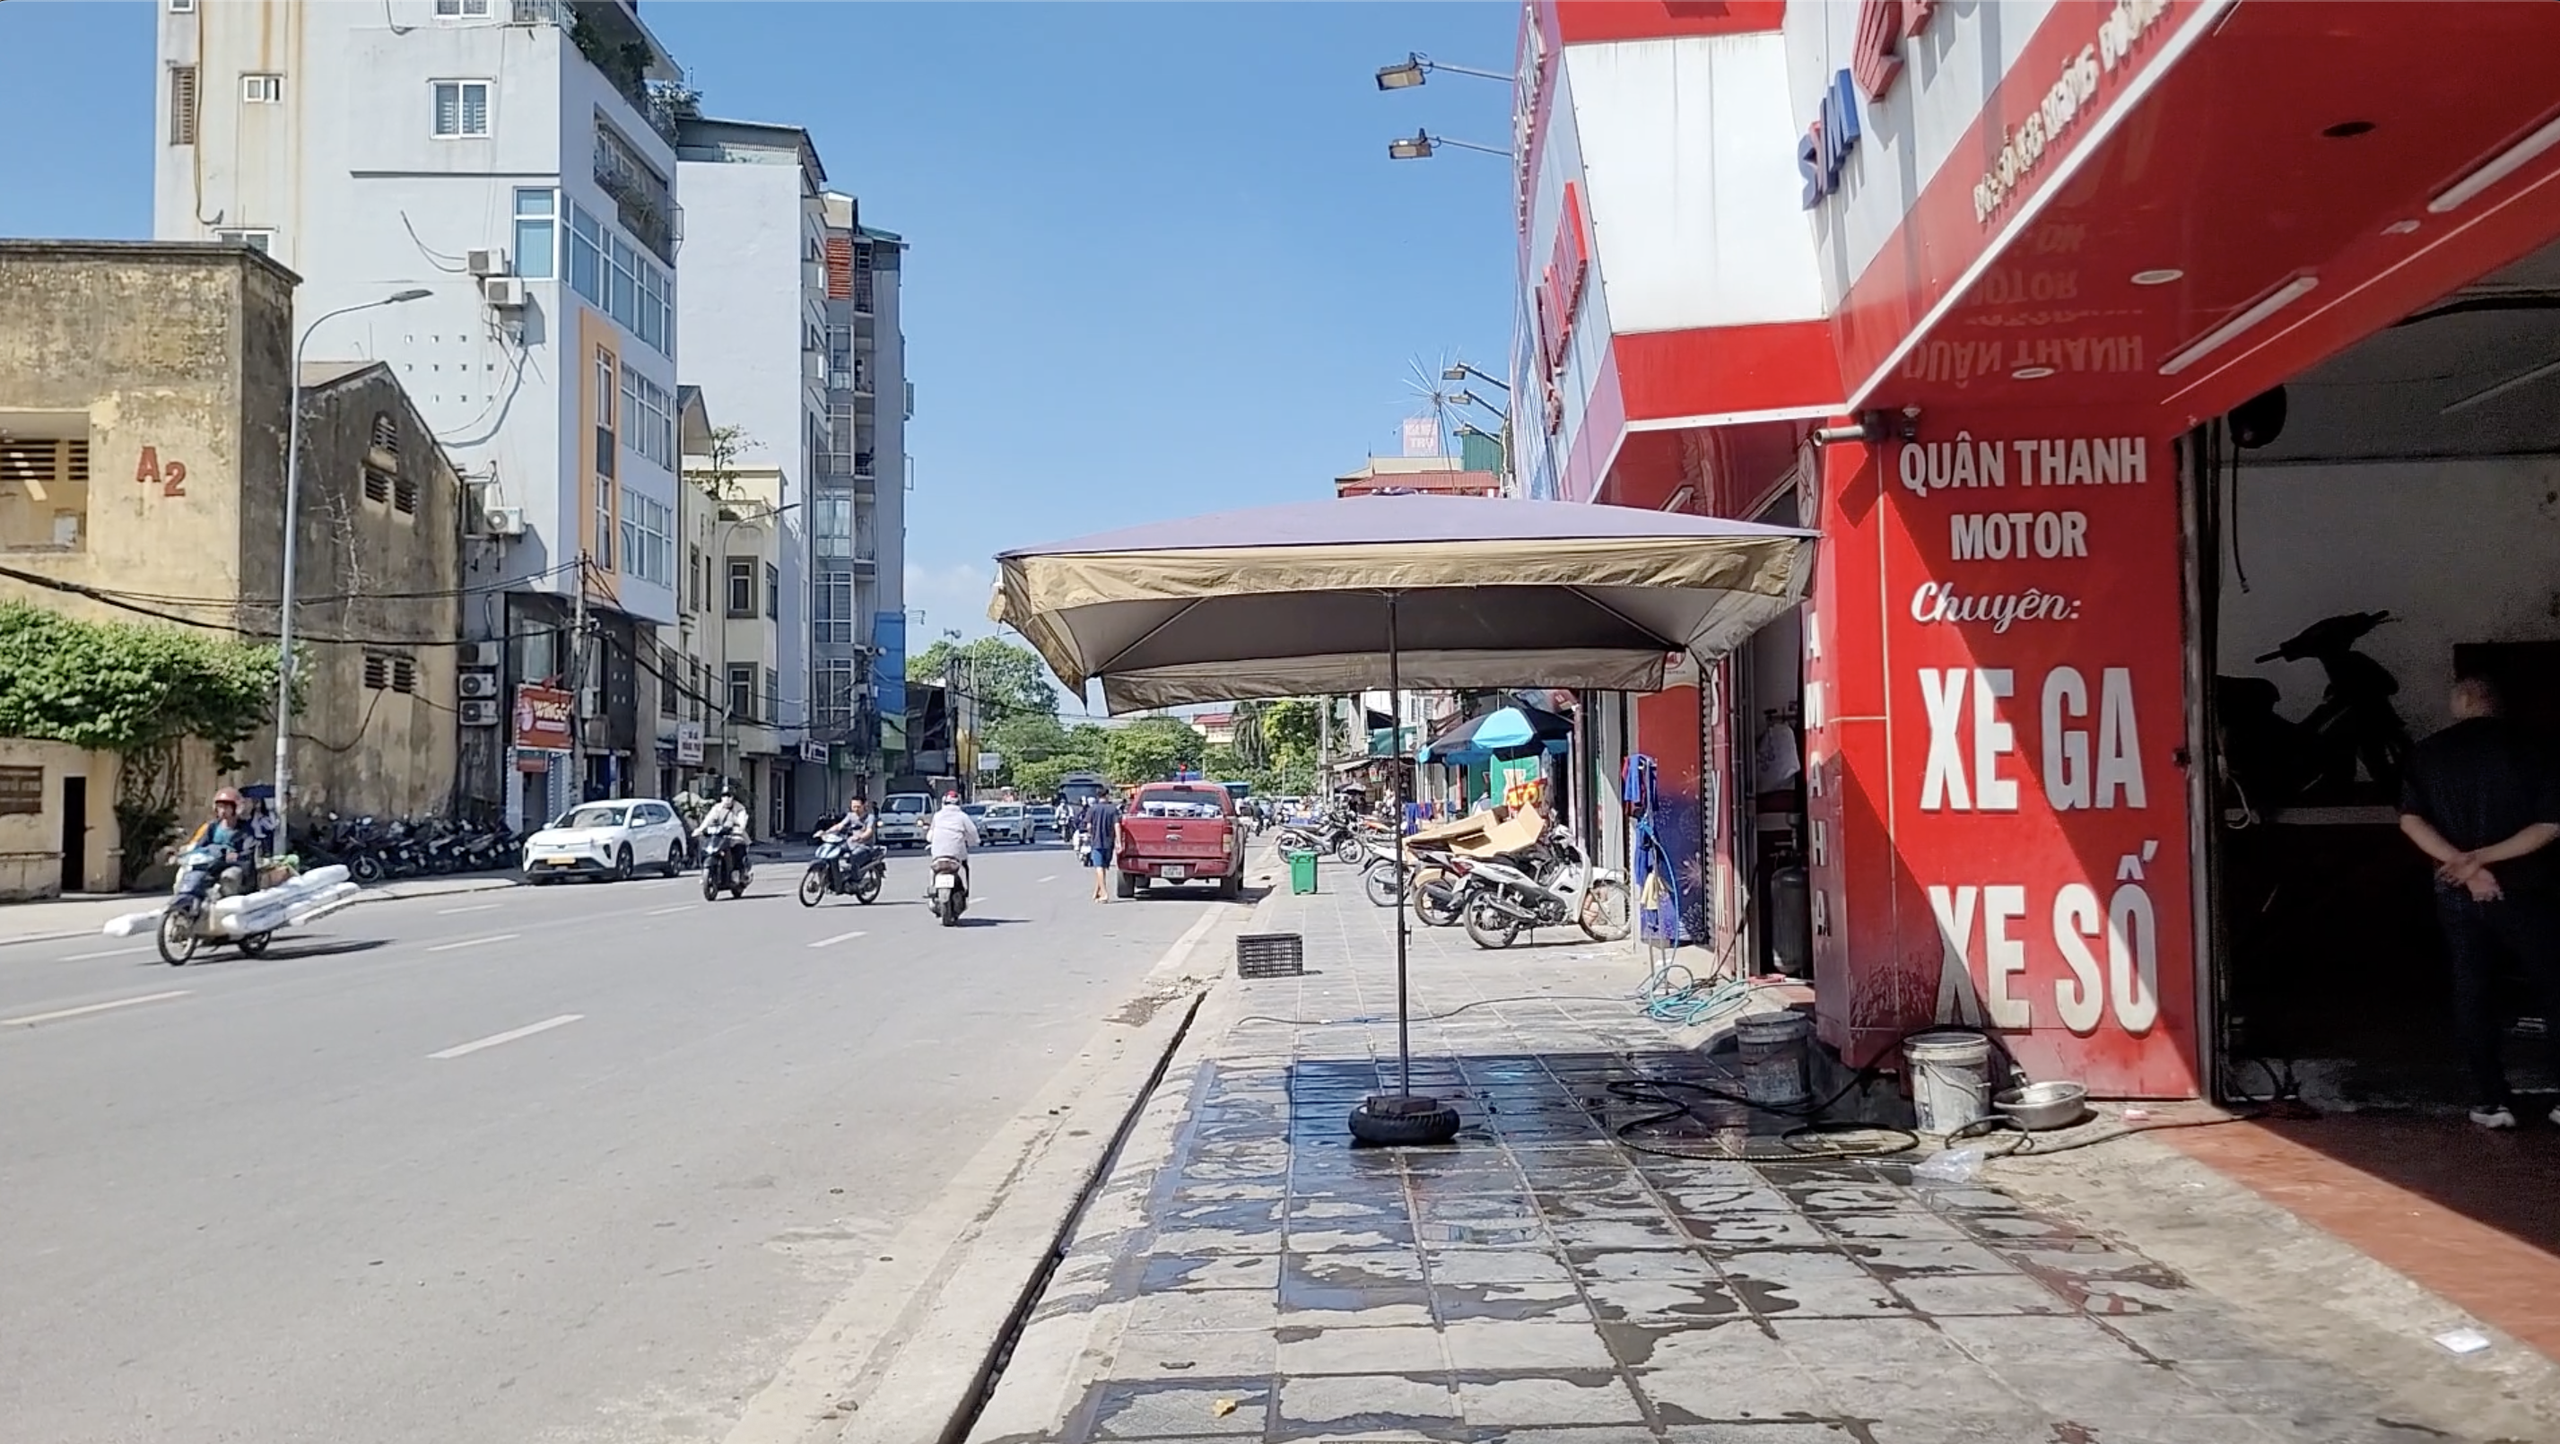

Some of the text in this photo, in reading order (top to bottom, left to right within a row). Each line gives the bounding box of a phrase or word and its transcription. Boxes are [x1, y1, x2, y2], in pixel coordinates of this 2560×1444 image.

[136, 446, 186, 497] A2
[1900, 431, 2147, 497] QUÂN THANH
[1950, 511, 2088, 560] MOTOR
[1911, 581, 2081, 634] Chuyên:
[1918, 666, 2147, 811] XE GA
[1804, 611, 1832, 937] AMAHA
[1928, 839, 2159, 1033] XE SỐ
